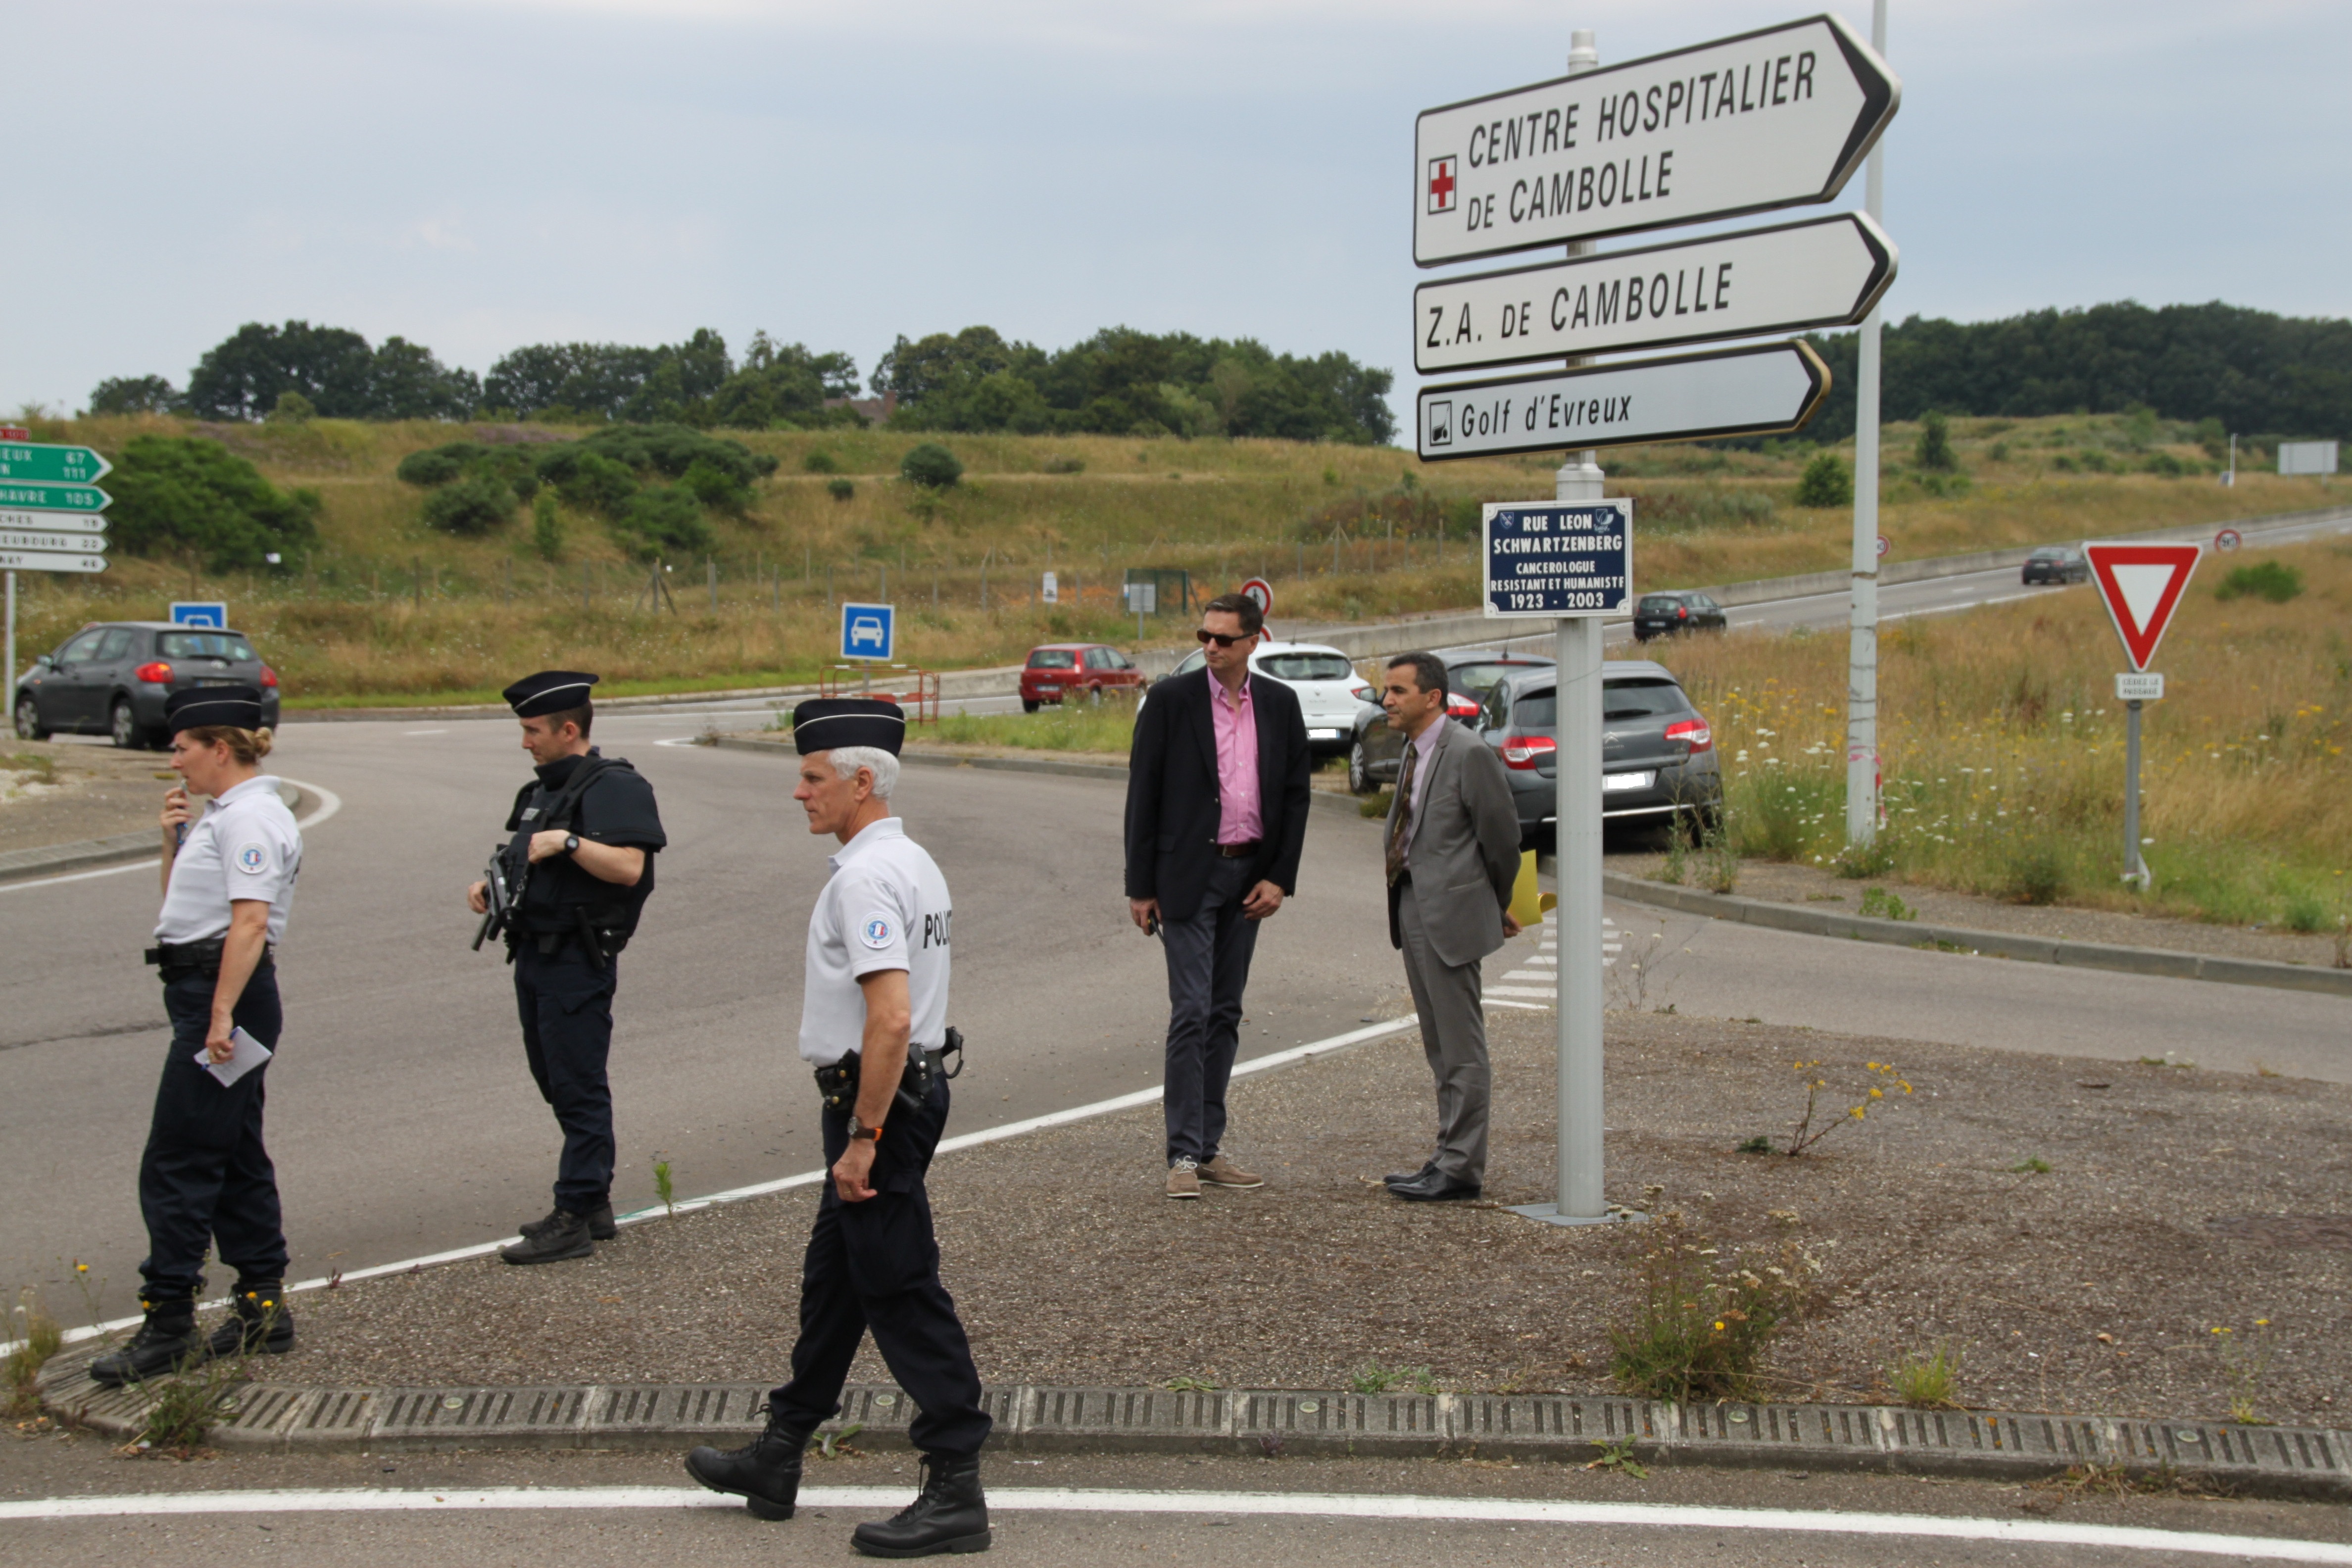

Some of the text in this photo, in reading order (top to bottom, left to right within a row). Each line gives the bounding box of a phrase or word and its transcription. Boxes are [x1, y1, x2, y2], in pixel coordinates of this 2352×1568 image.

[1470, 51, 1816, 168] CENTRE HOSPITALIER
[1467, 150, 1673, 231] DE CAMBOLLE
[1426, 262, 1732, 348] Z.A. DE CAMBOLLE
[1462, 393, 1632, 438] Golf d'Evreux
[65, 451, 86, 464] 67
[62, 466, 86, 480] 111
[1523, 515, 1548, 532] RUE
[1560, 514, 1592, 530] LEON
[1494, 535, 1622, 554] SCHWARTZENBERG
[1516, 560, 1595, 574] CANCEROLOGUE
[1491, 576, 1624, 591] RESISTANT ET HUMANISTE
[1511, 593, 1543, 608] 1923
[1567, 592, 1604, 607] 2003
